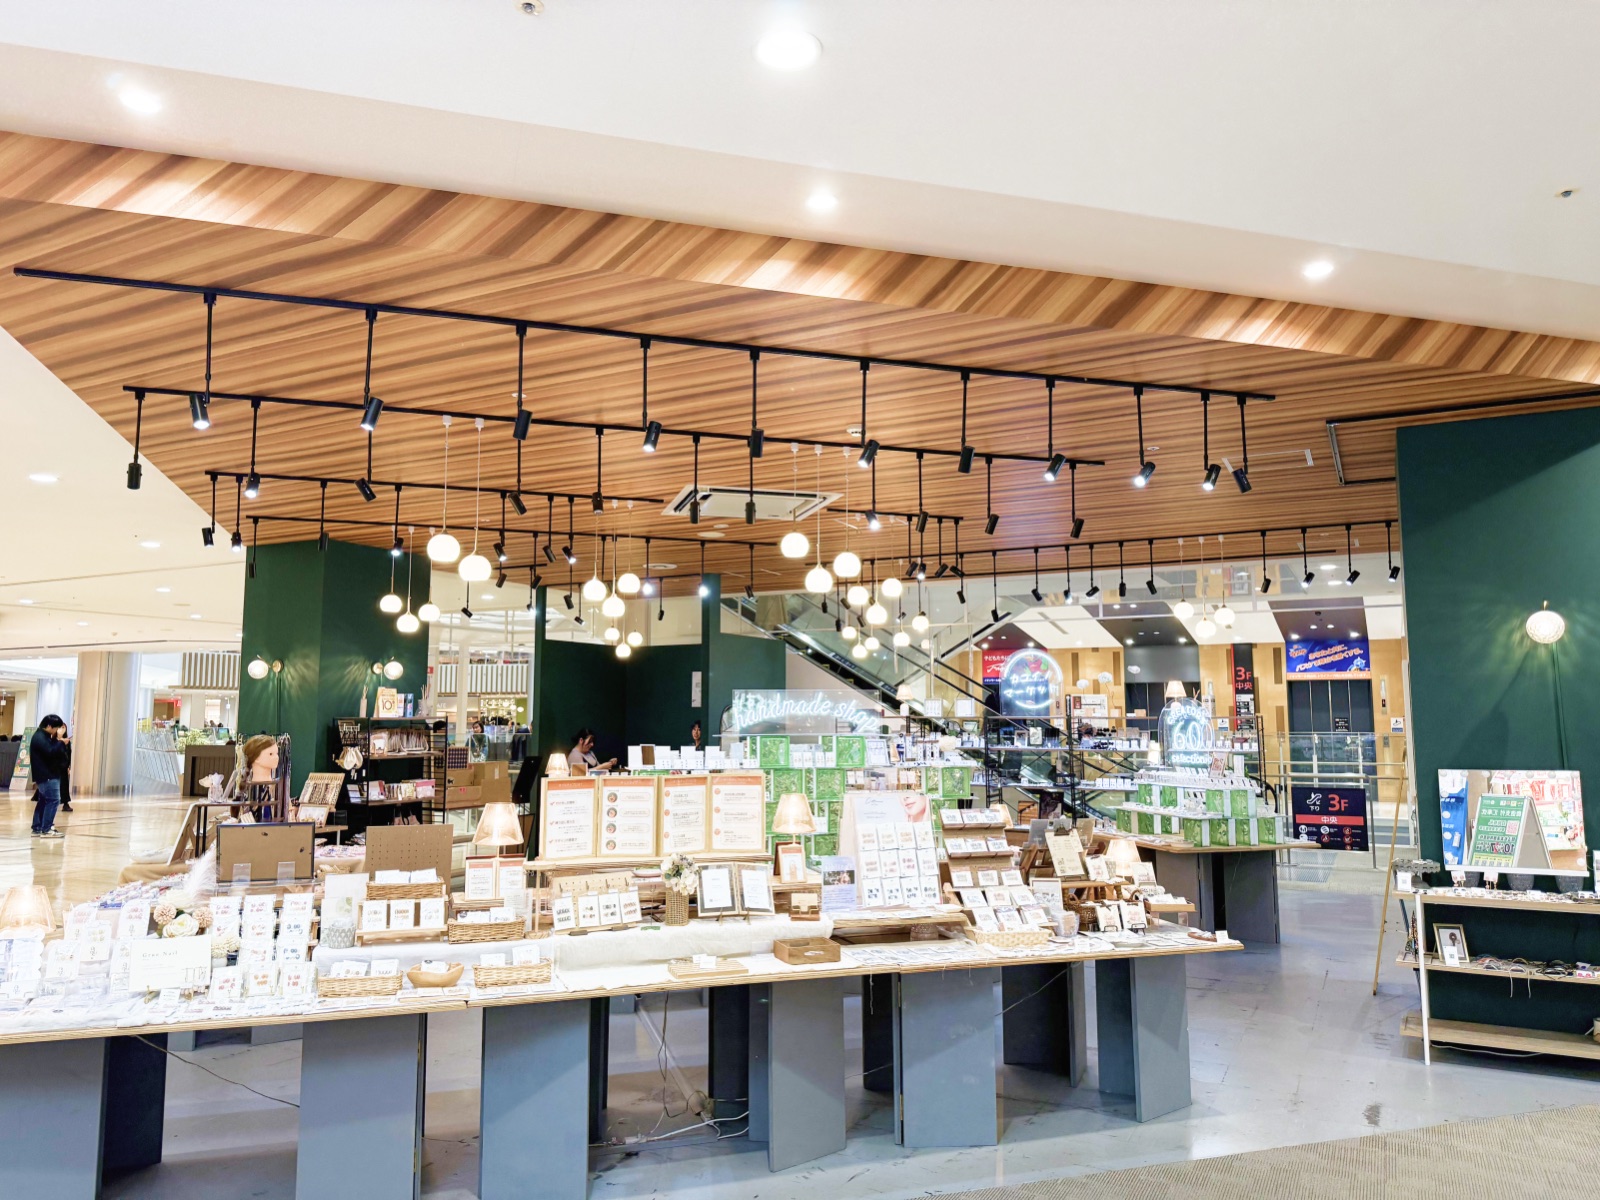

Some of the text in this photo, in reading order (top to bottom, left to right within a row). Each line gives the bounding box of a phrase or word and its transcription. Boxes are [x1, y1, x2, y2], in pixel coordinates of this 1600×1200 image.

[1235, 666, 1252, 681] 3F
[1235, 681, 1253, 690] 中央
[733, 691, 879, 733] handmade shop
[1173, 720, 1213, 750] 600
[1328, 793, 1349, 811] 3F
[1321, 815, 1338, 824] 中央
